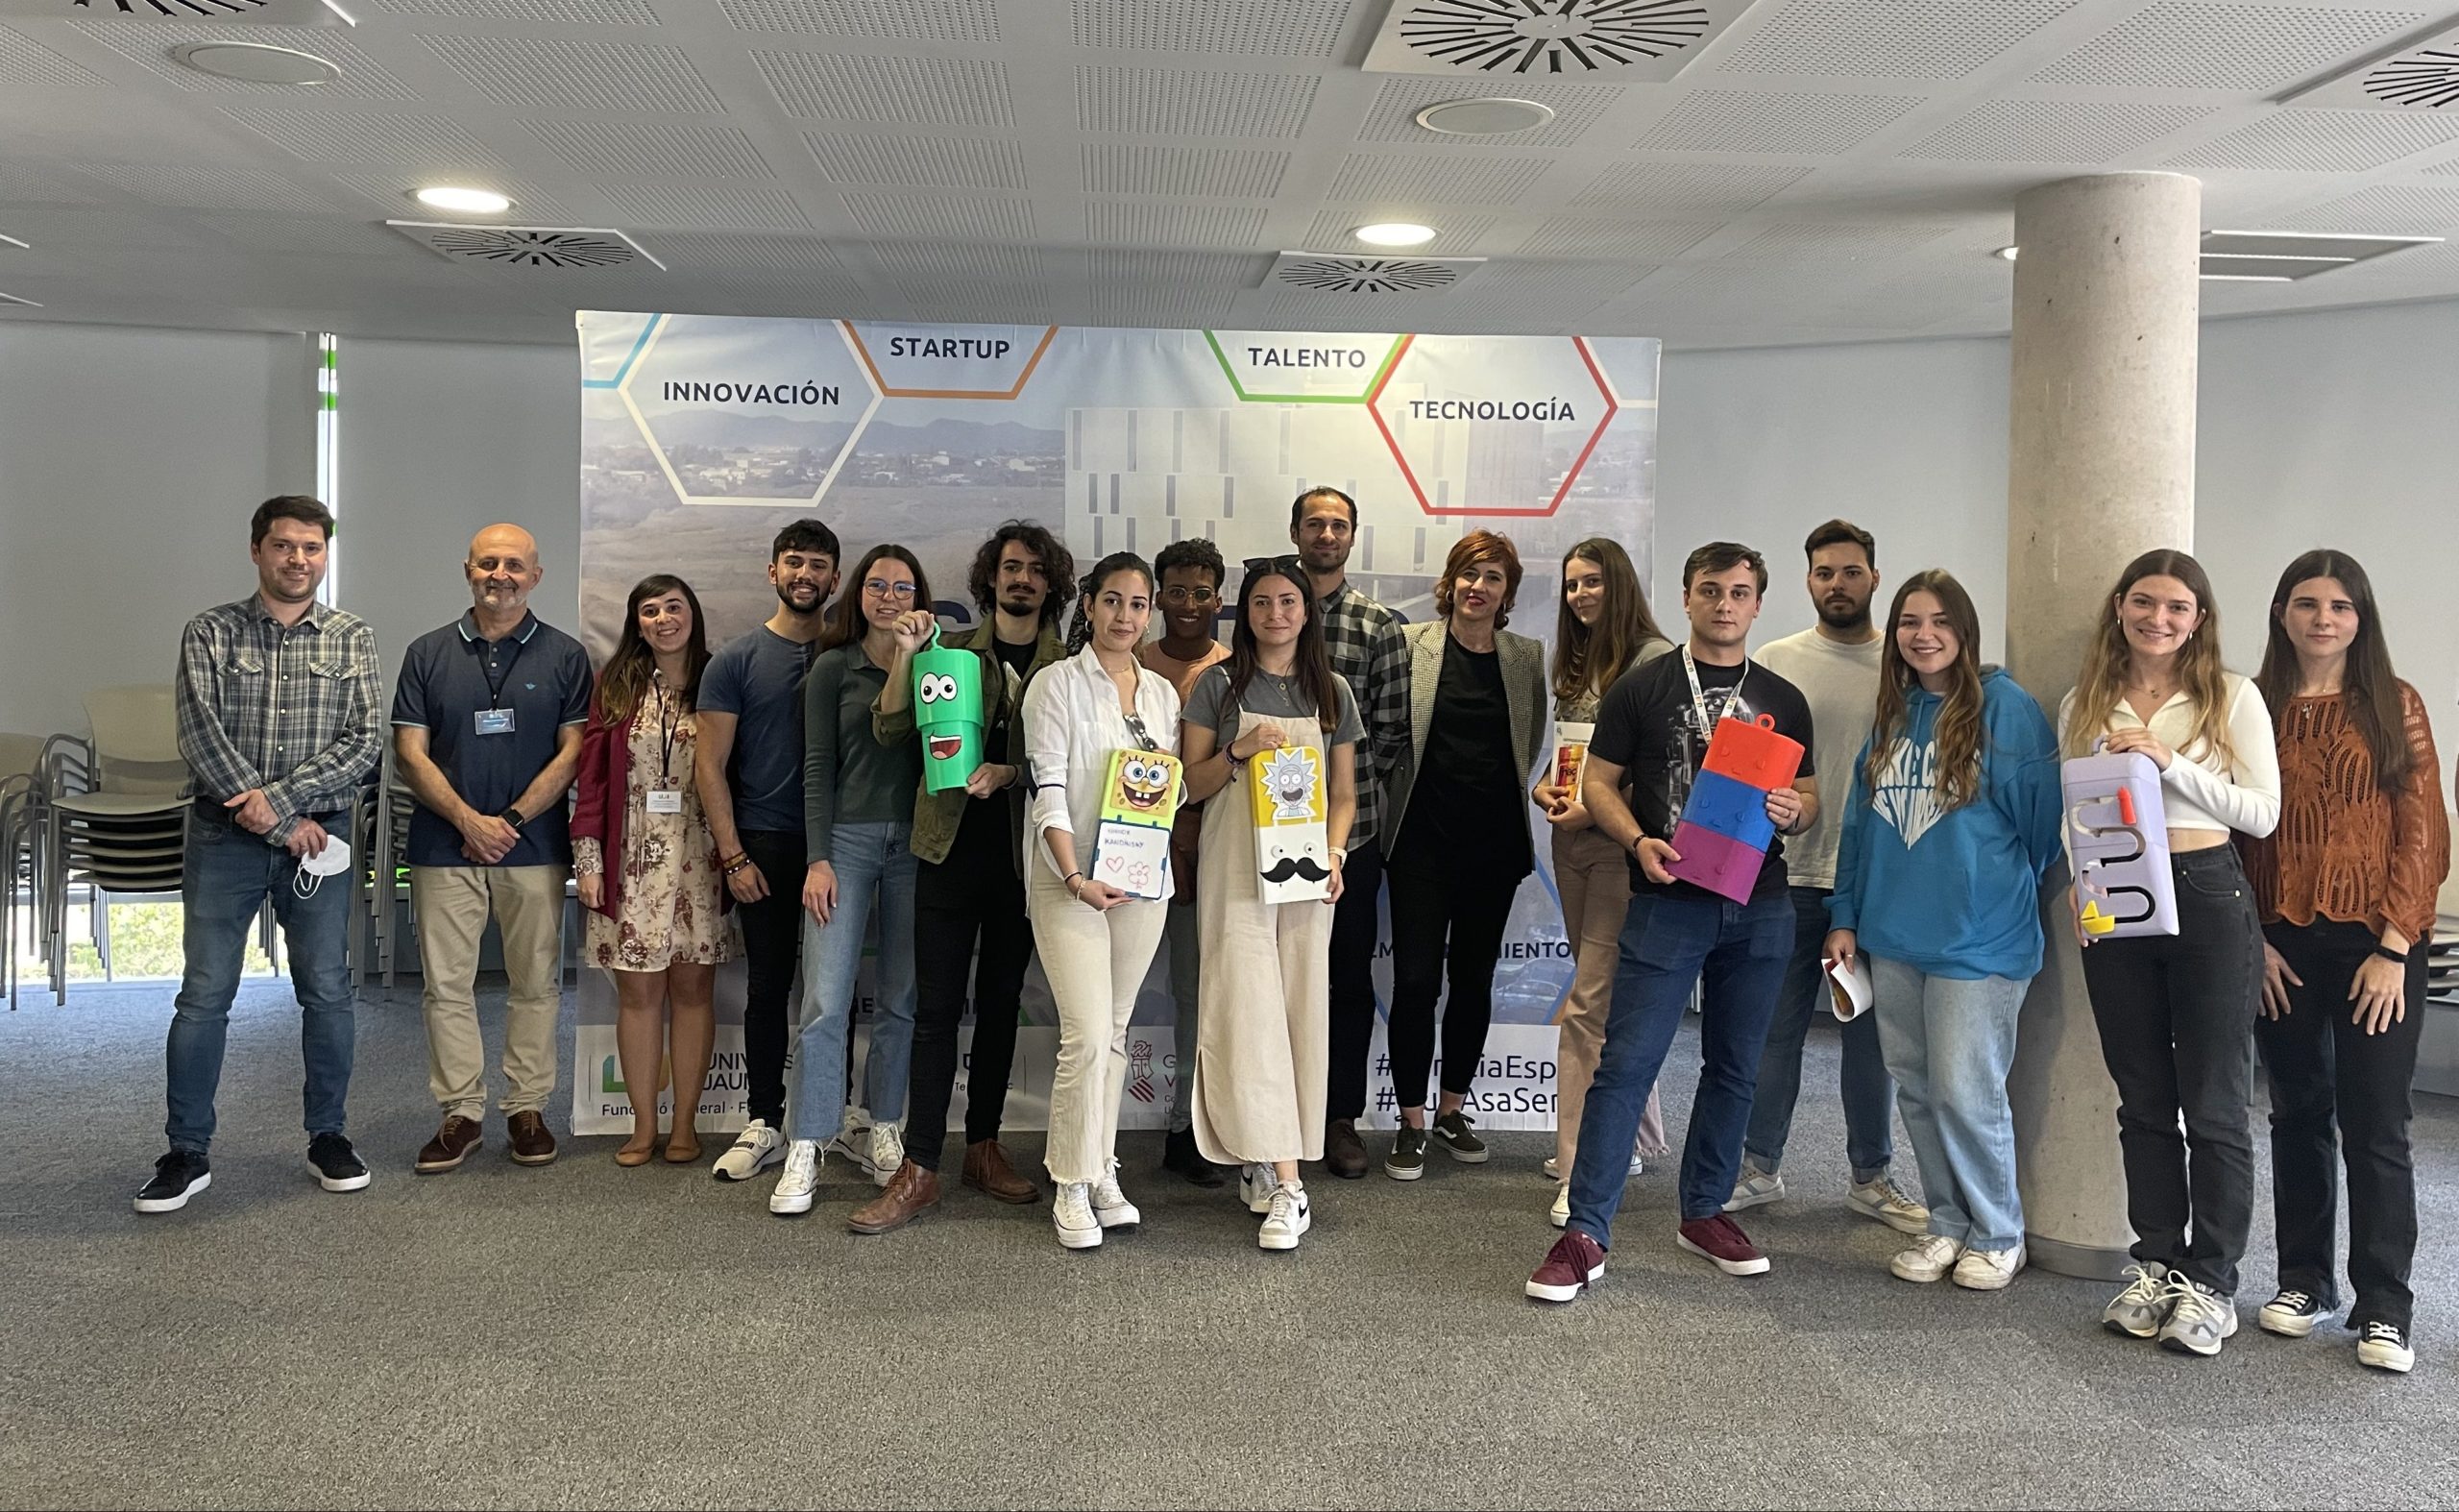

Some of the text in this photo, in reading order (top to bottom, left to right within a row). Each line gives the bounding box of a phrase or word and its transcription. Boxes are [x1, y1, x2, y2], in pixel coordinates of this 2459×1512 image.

[890, 336, 1010, 359] STARTUP
[1248, 347, 1366, 368] TALENTO
[663, 380, 840, 405] INNOVACIÓN
[1409, 396, 1575, 421] TECNOLOGÍA
